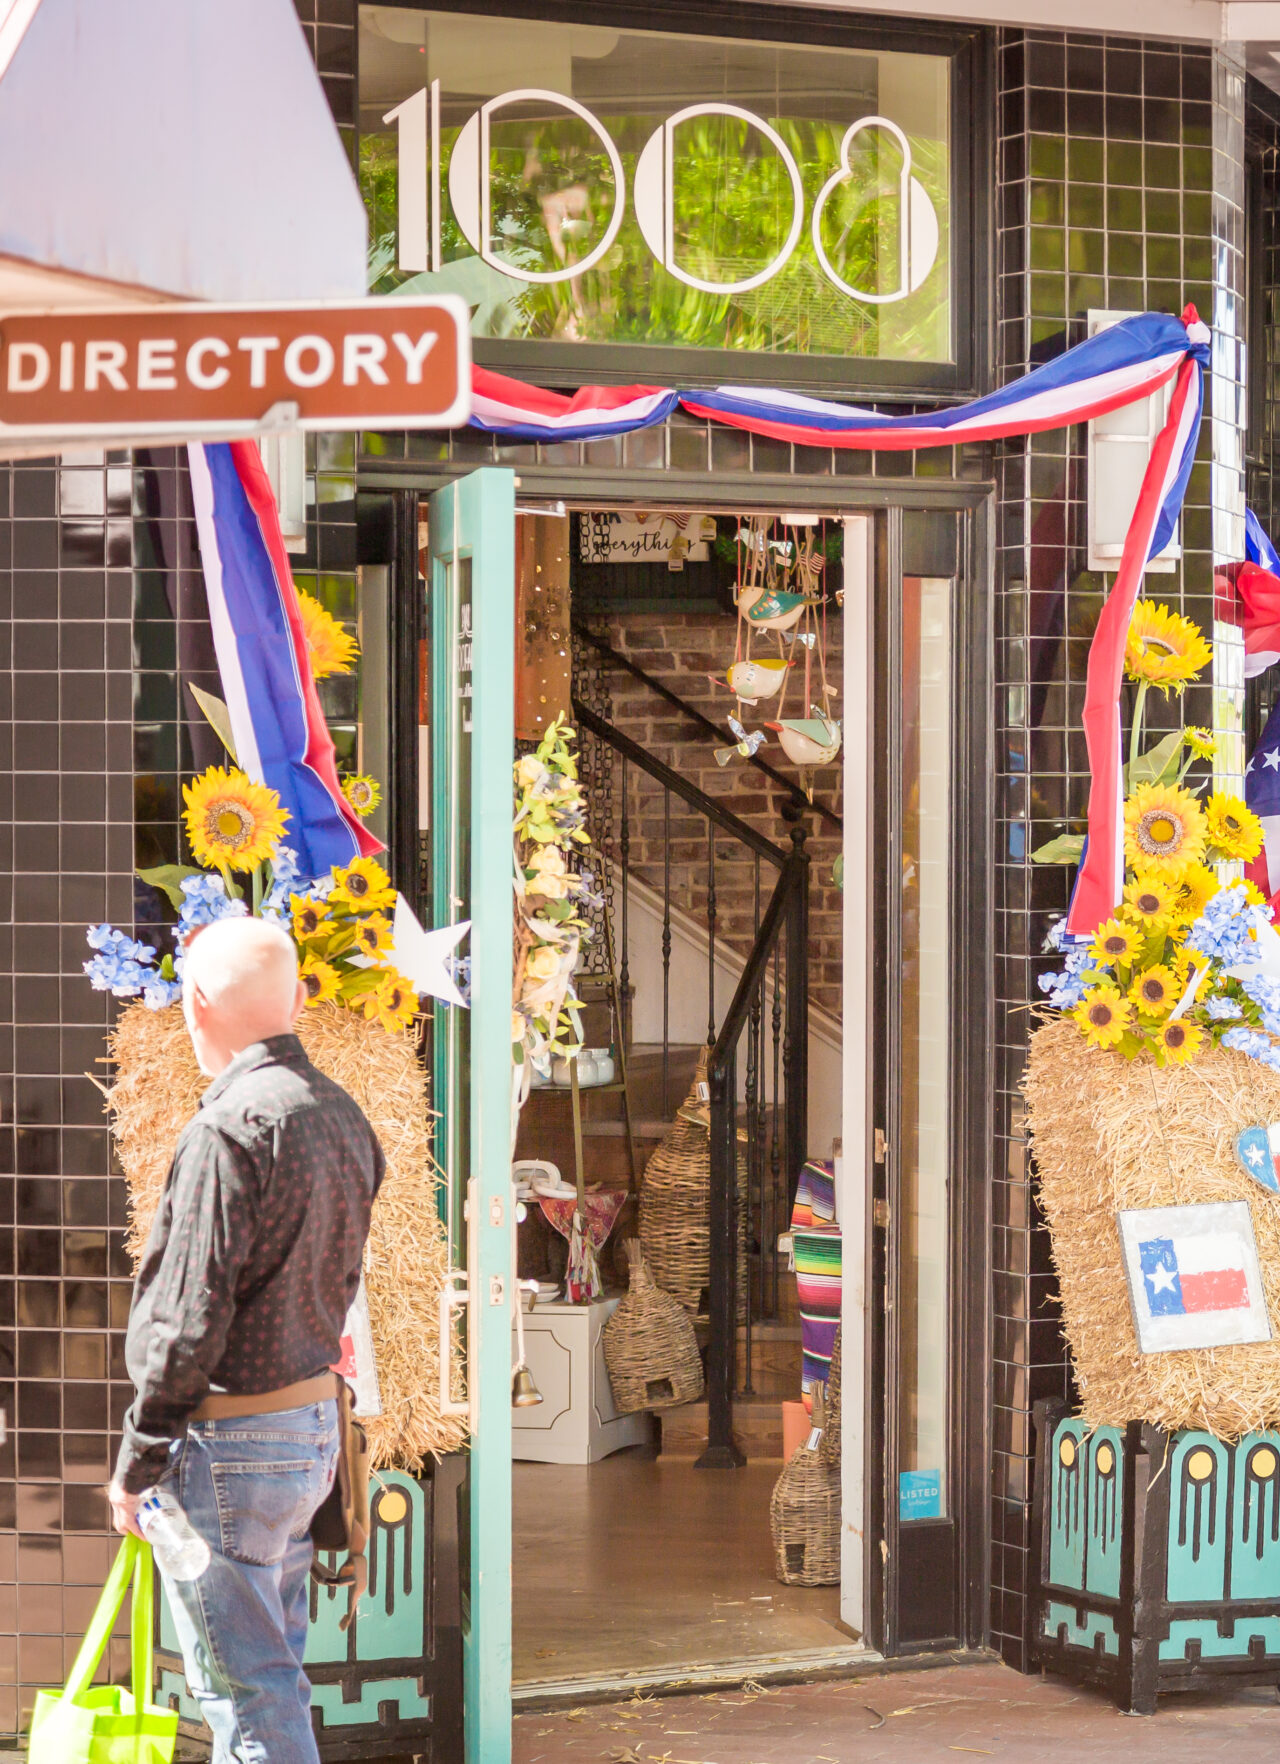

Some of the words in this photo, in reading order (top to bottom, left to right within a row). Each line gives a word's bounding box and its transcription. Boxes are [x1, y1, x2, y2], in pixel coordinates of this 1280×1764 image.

[382, 78, 939, 304] 1008
[7, 331, 438, 393] DIRECTORY
[900, 1488, 938, 1500] LISTED
